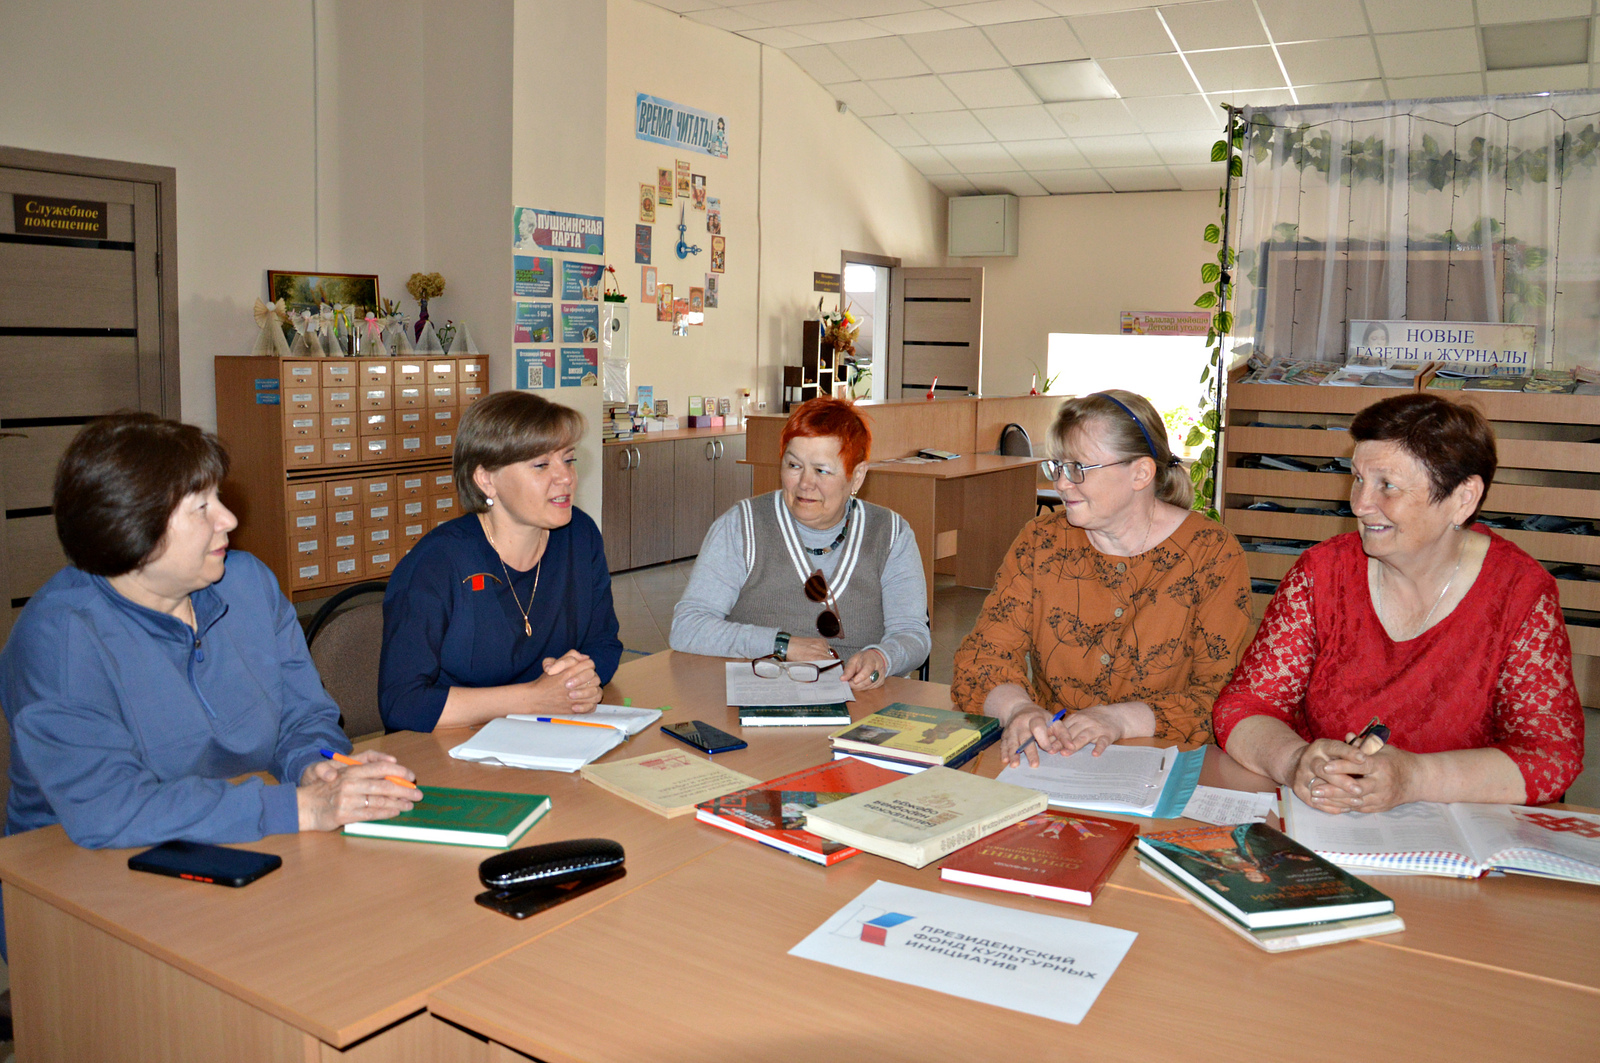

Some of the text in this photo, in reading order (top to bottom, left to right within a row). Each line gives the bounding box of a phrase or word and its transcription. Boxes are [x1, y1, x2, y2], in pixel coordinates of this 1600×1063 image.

[638, 101, 714, 148] ВРЕМЯ ЧИТАТЬ!
[25, 201, 99, 219] Служебное
[24, 217, 100, 232] помещение
[537, 213, 603, 236] ПУШКИНСКАЯ
[551, 230, 582, 248] КАРТА
[1144, 316, 1175, 326] Балалар
[1147, 324, 1178, 332] Детский
[1407, 328, 1475, 344] НОВЫЕ
[1356, 346, 1528, 364] ГАЗЕТЫ и ЖУРНАЛЫ
[863, 804, 937, 828] Башкирская
[872, 800, 930, 819] народная
[892, 799, 939, 815] одежда
[978, 848, 1080, 870] ОРНАМЕНТ
[920, 925, 1076, 965] ПРЕЗИДЕНТСКИЙ
[904, 940, 1018, 971] ИНИЦИАТИВ
[912, 933, 1098, 979] ФОНД КУЛЬТУРНЫХ
